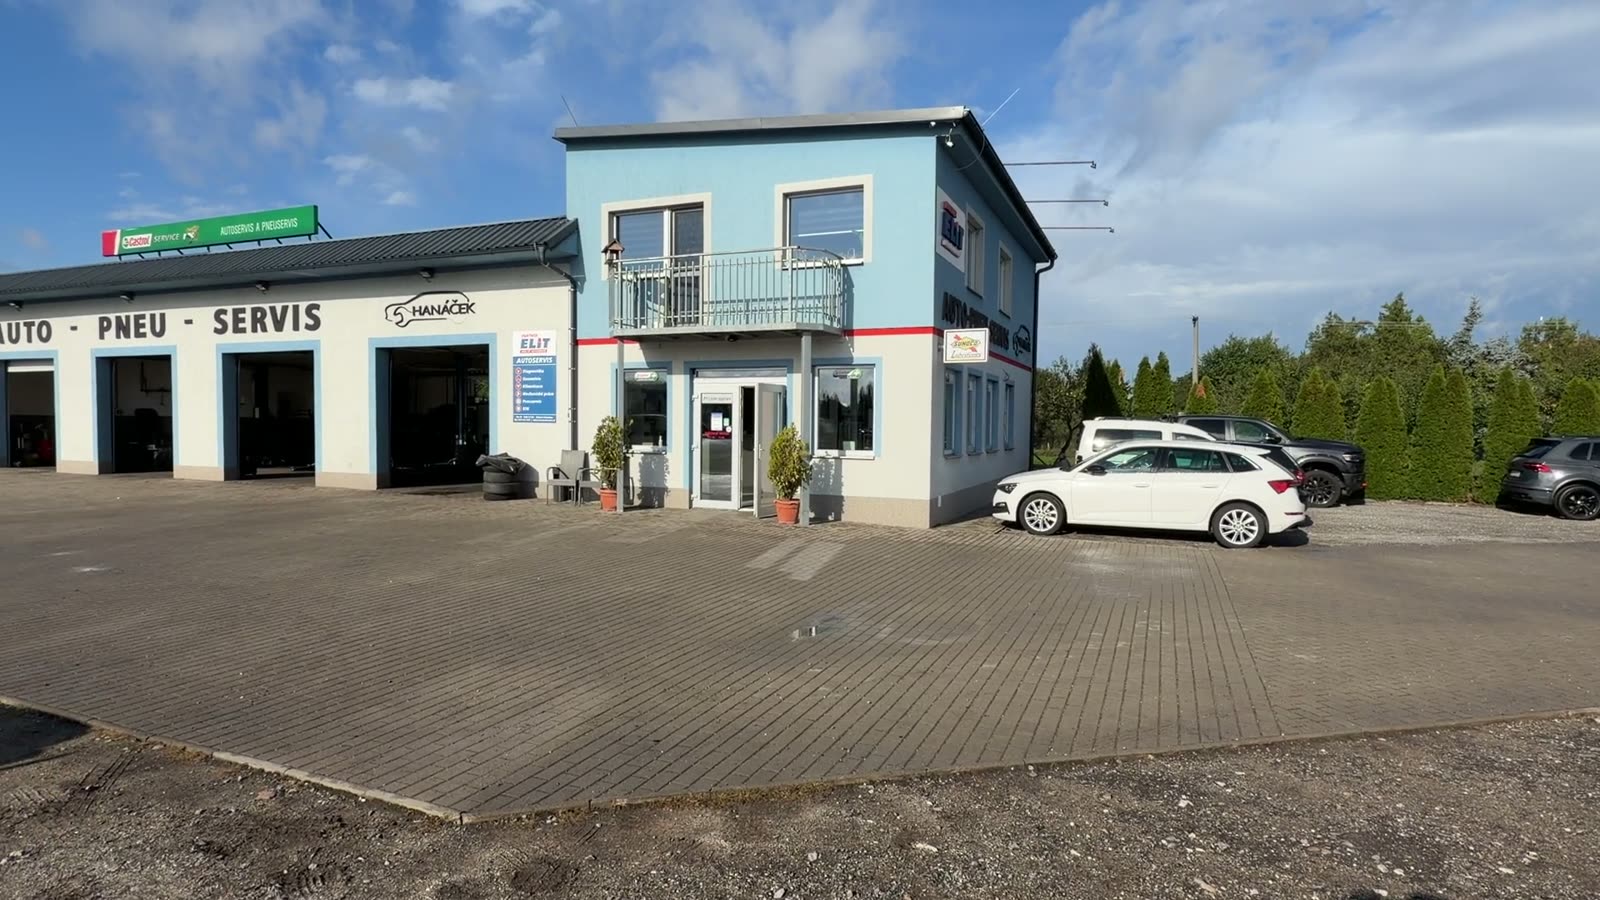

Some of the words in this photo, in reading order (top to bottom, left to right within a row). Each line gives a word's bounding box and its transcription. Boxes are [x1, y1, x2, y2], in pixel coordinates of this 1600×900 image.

[220, 223, 254, 236] AUTOSERVIS
[255, 222, 260, 232] A
[261, 218, 298, 232] PNEUSERVIS
[128, 235, 150, 247] Castrol
[153, 233, 180, 243] SERVICE
[412, 299, 476, 317] HANÁČEK
[98, 312, 166, 340] PNEU
[213, 303, 321, 335] SERVIS
[520, 338, 551, 349] ELIT
